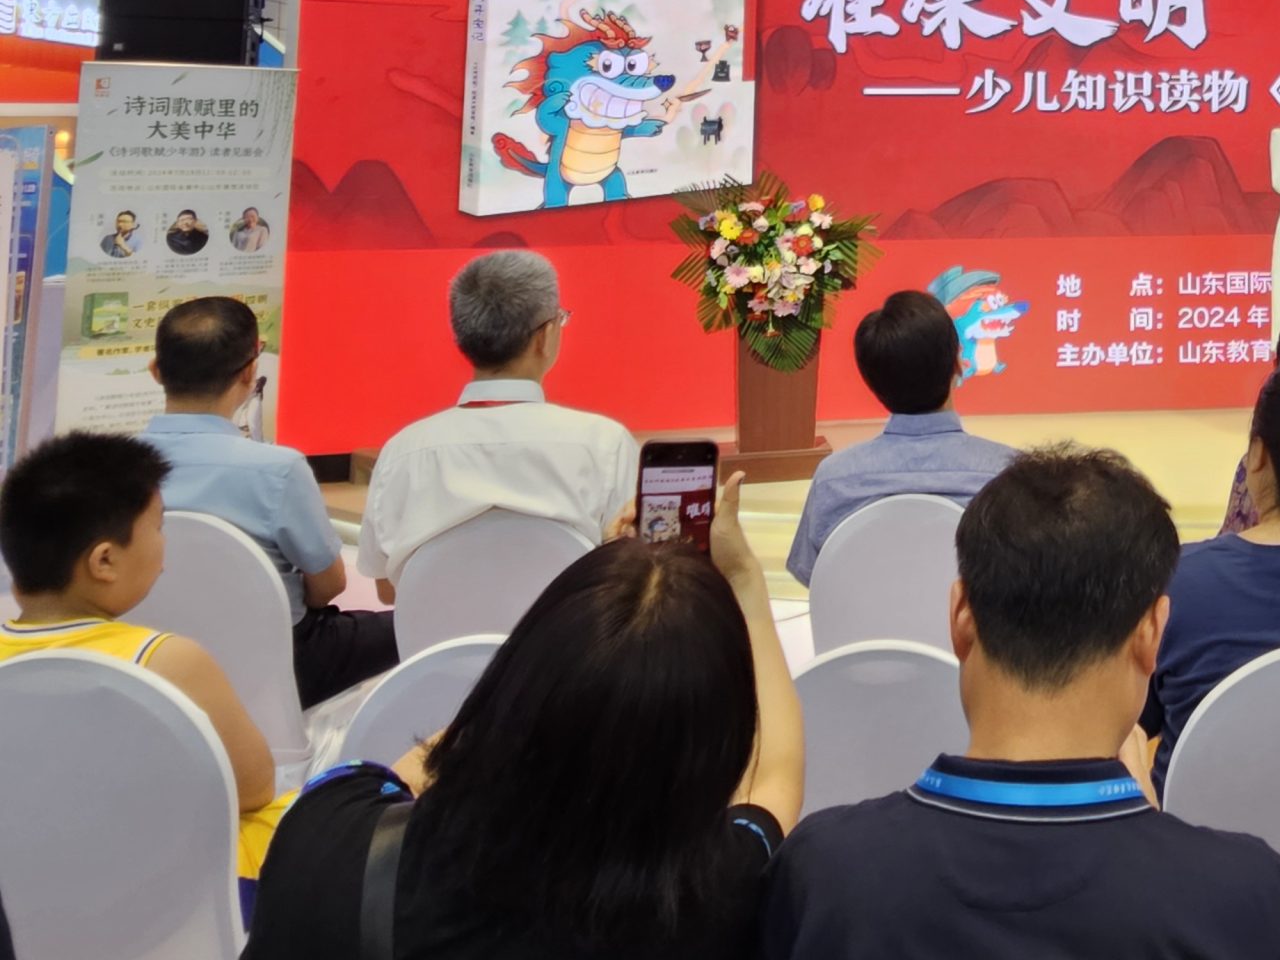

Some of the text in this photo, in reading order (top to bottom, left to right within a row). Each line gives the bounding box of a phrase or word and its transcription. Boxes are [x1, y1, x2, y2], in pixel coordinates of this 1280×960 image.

[124, 95, 260, 119] 诗词歌赋里的
[147, 120, 237, 141] 大美中华
